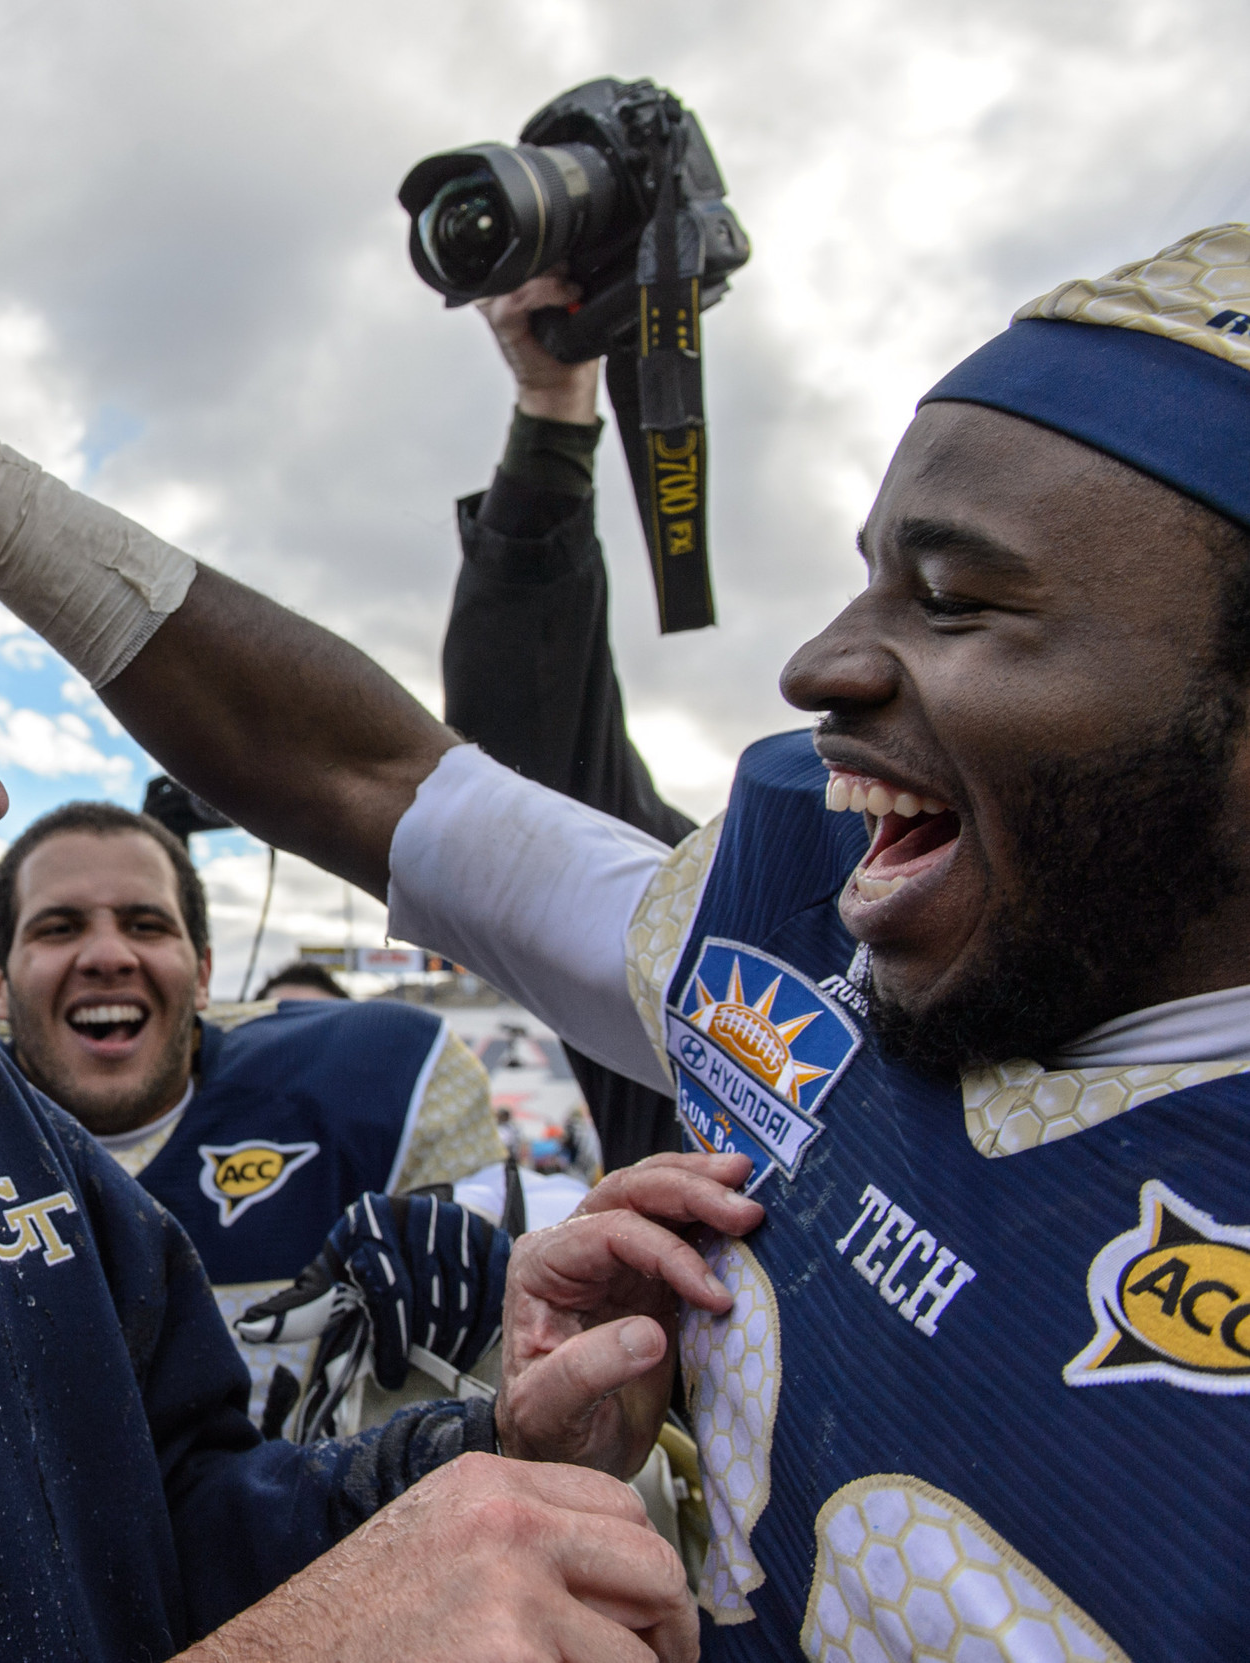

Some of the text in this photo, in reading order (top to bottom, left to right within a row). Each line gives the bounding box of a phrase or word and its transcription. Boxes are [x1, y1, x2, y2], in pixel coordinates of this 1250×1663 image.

[681, 1088, 711, 1136] SUN
[708, 1057, 792, 1146] HYUNDAI
[220, 1159, 275, 1186] ACC
[835, 1183, 977, 1338] TECH
